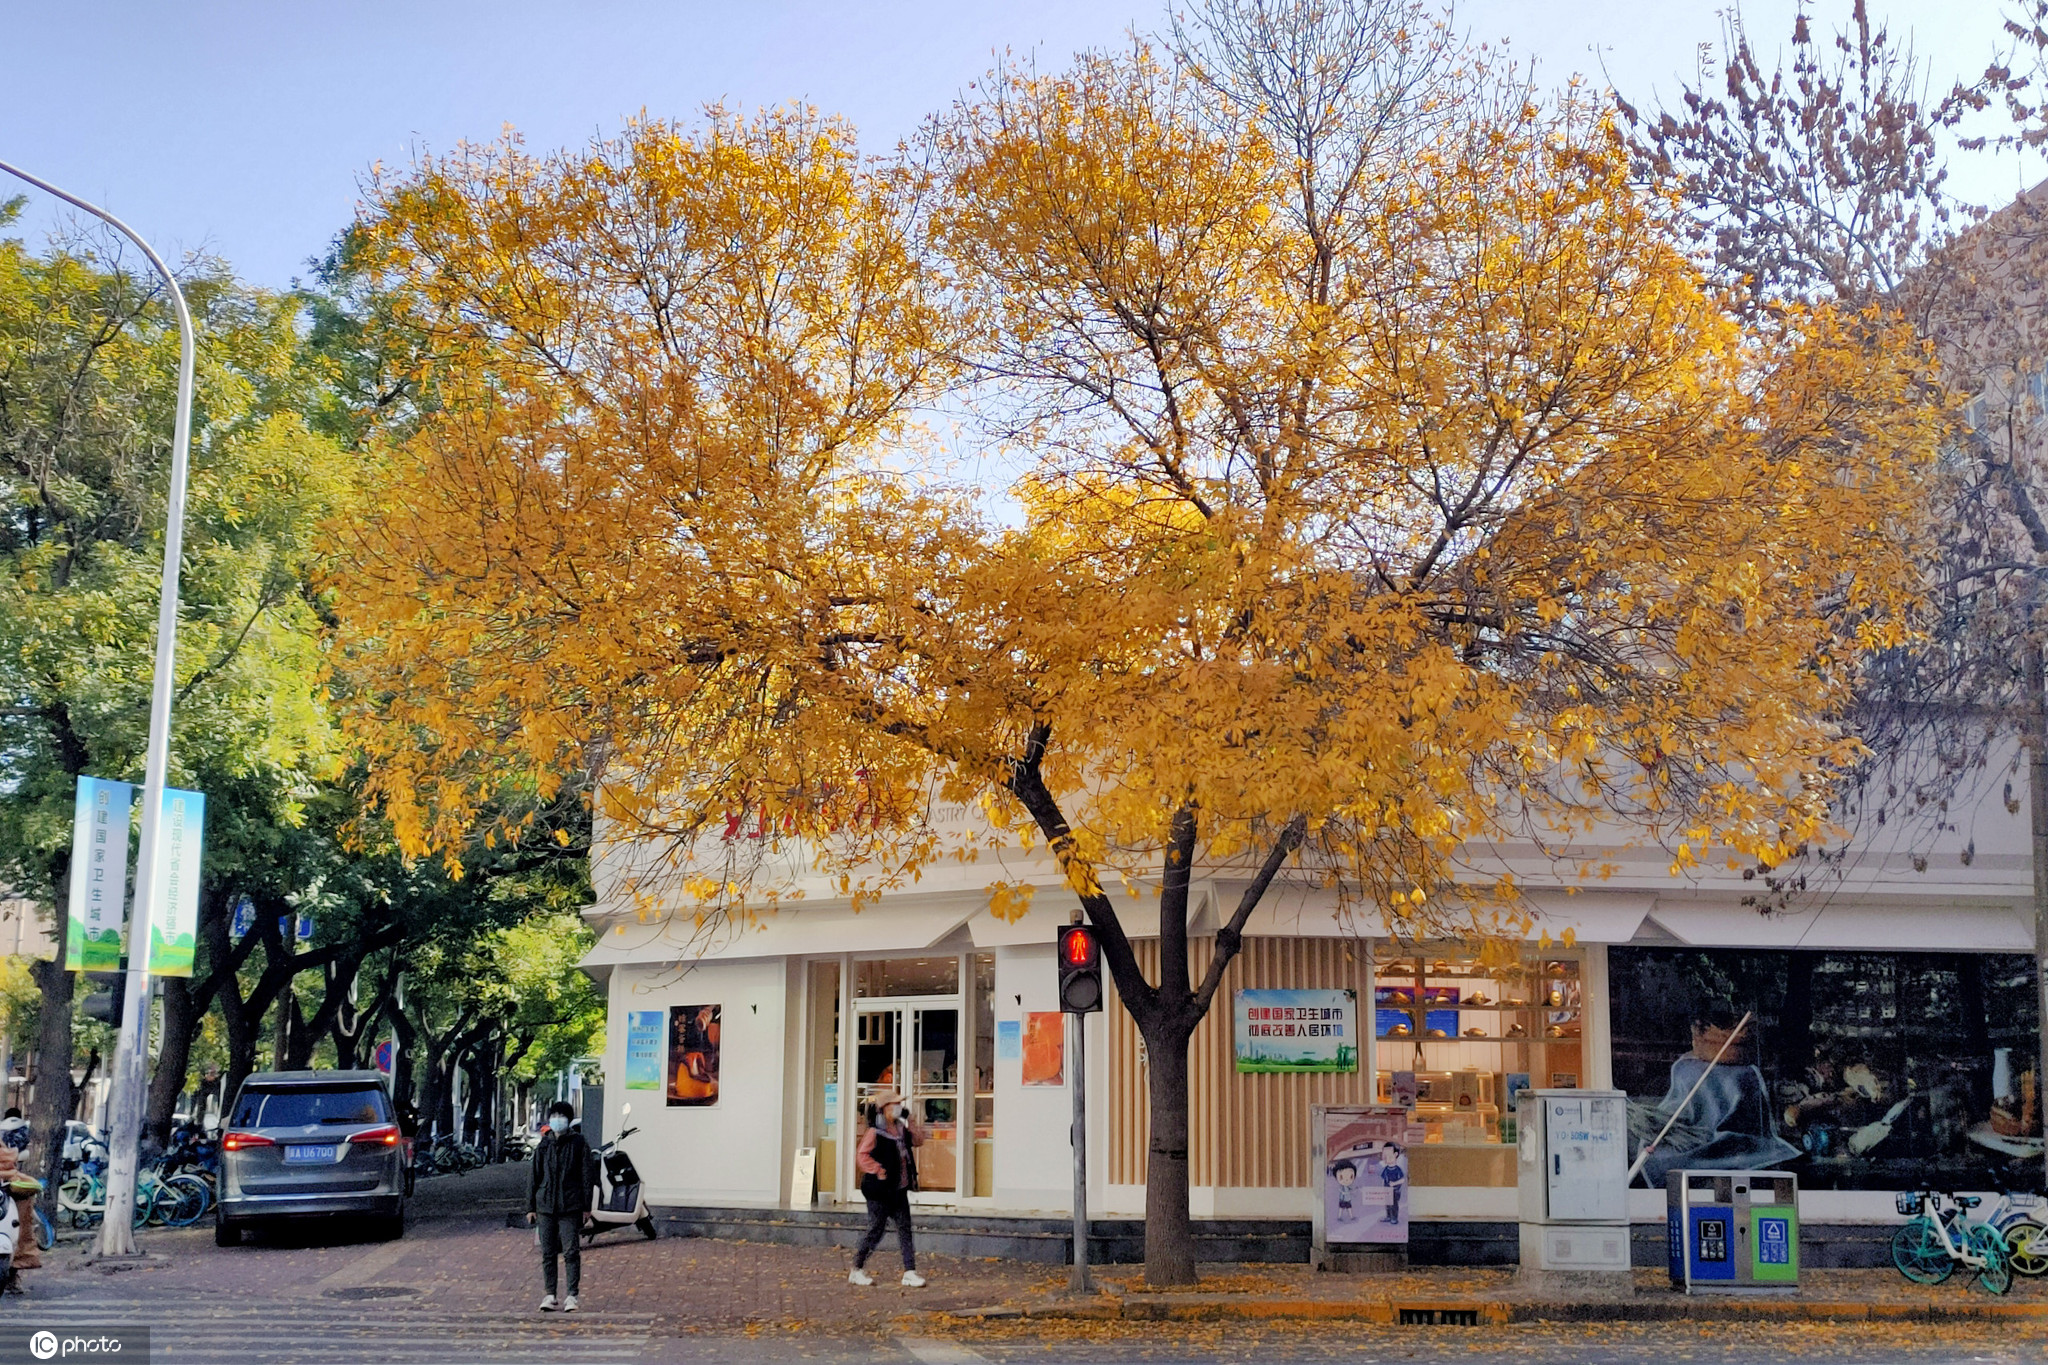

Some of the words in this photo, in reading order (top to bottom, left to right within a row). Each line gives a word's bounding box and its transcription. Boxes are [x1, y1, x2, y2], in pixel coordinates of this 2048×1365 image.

[926, 806, 967, 823] ASTRY
[89, 790, 109, 941] 创建国家卫生城市
[1248, 1008, 1343, 1020] 创建国家卫生城市
[1248, 1024, 1344, 1037] 彻底改善人居环境
